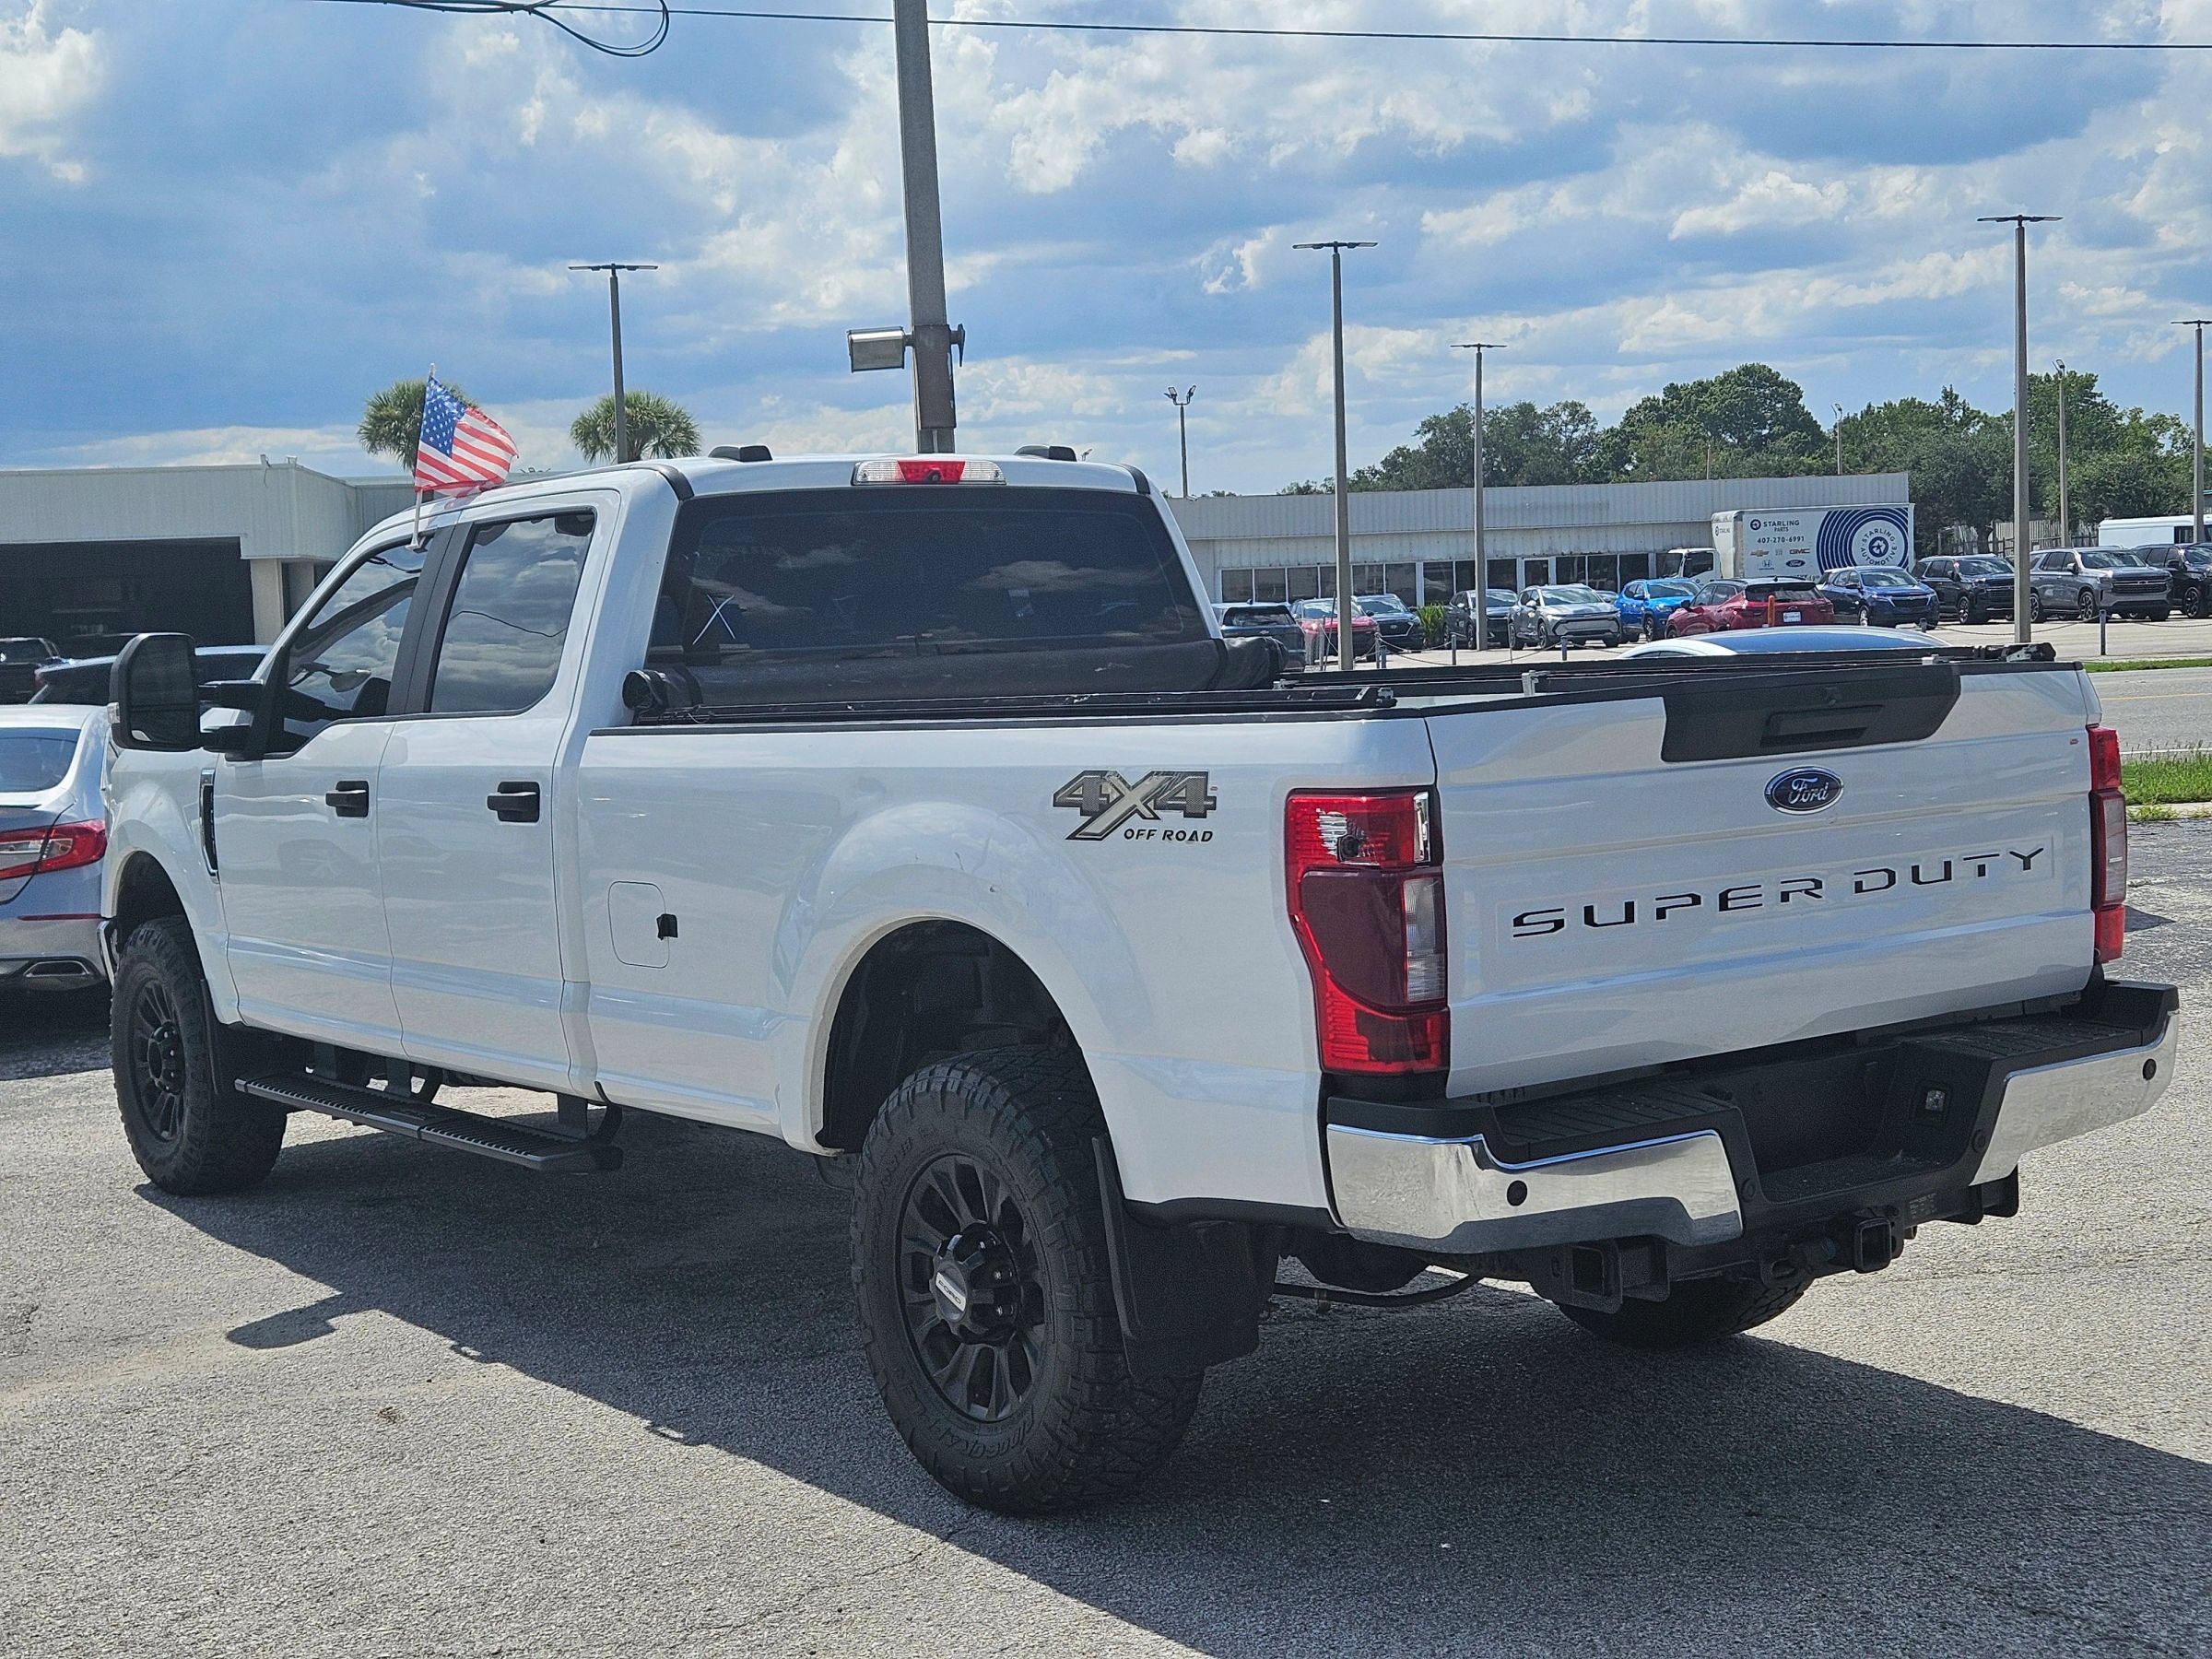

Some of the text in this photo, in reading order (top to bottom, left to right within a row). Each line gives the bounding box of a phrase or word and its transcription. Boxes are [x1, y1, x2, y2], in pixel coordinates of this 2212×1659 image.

[1757, 535, 1805, 544] 407-270-6991
[1862, 528, 1895, 543] STARLING
[1860, 546, 1897, 566] AUTOMOTIVE
[1124, 828, 1214, 842] OFF ROAD
[1512, 847, 2044, 938] SUPER DUTY
[938, 1280, 961, 1304] FORD
